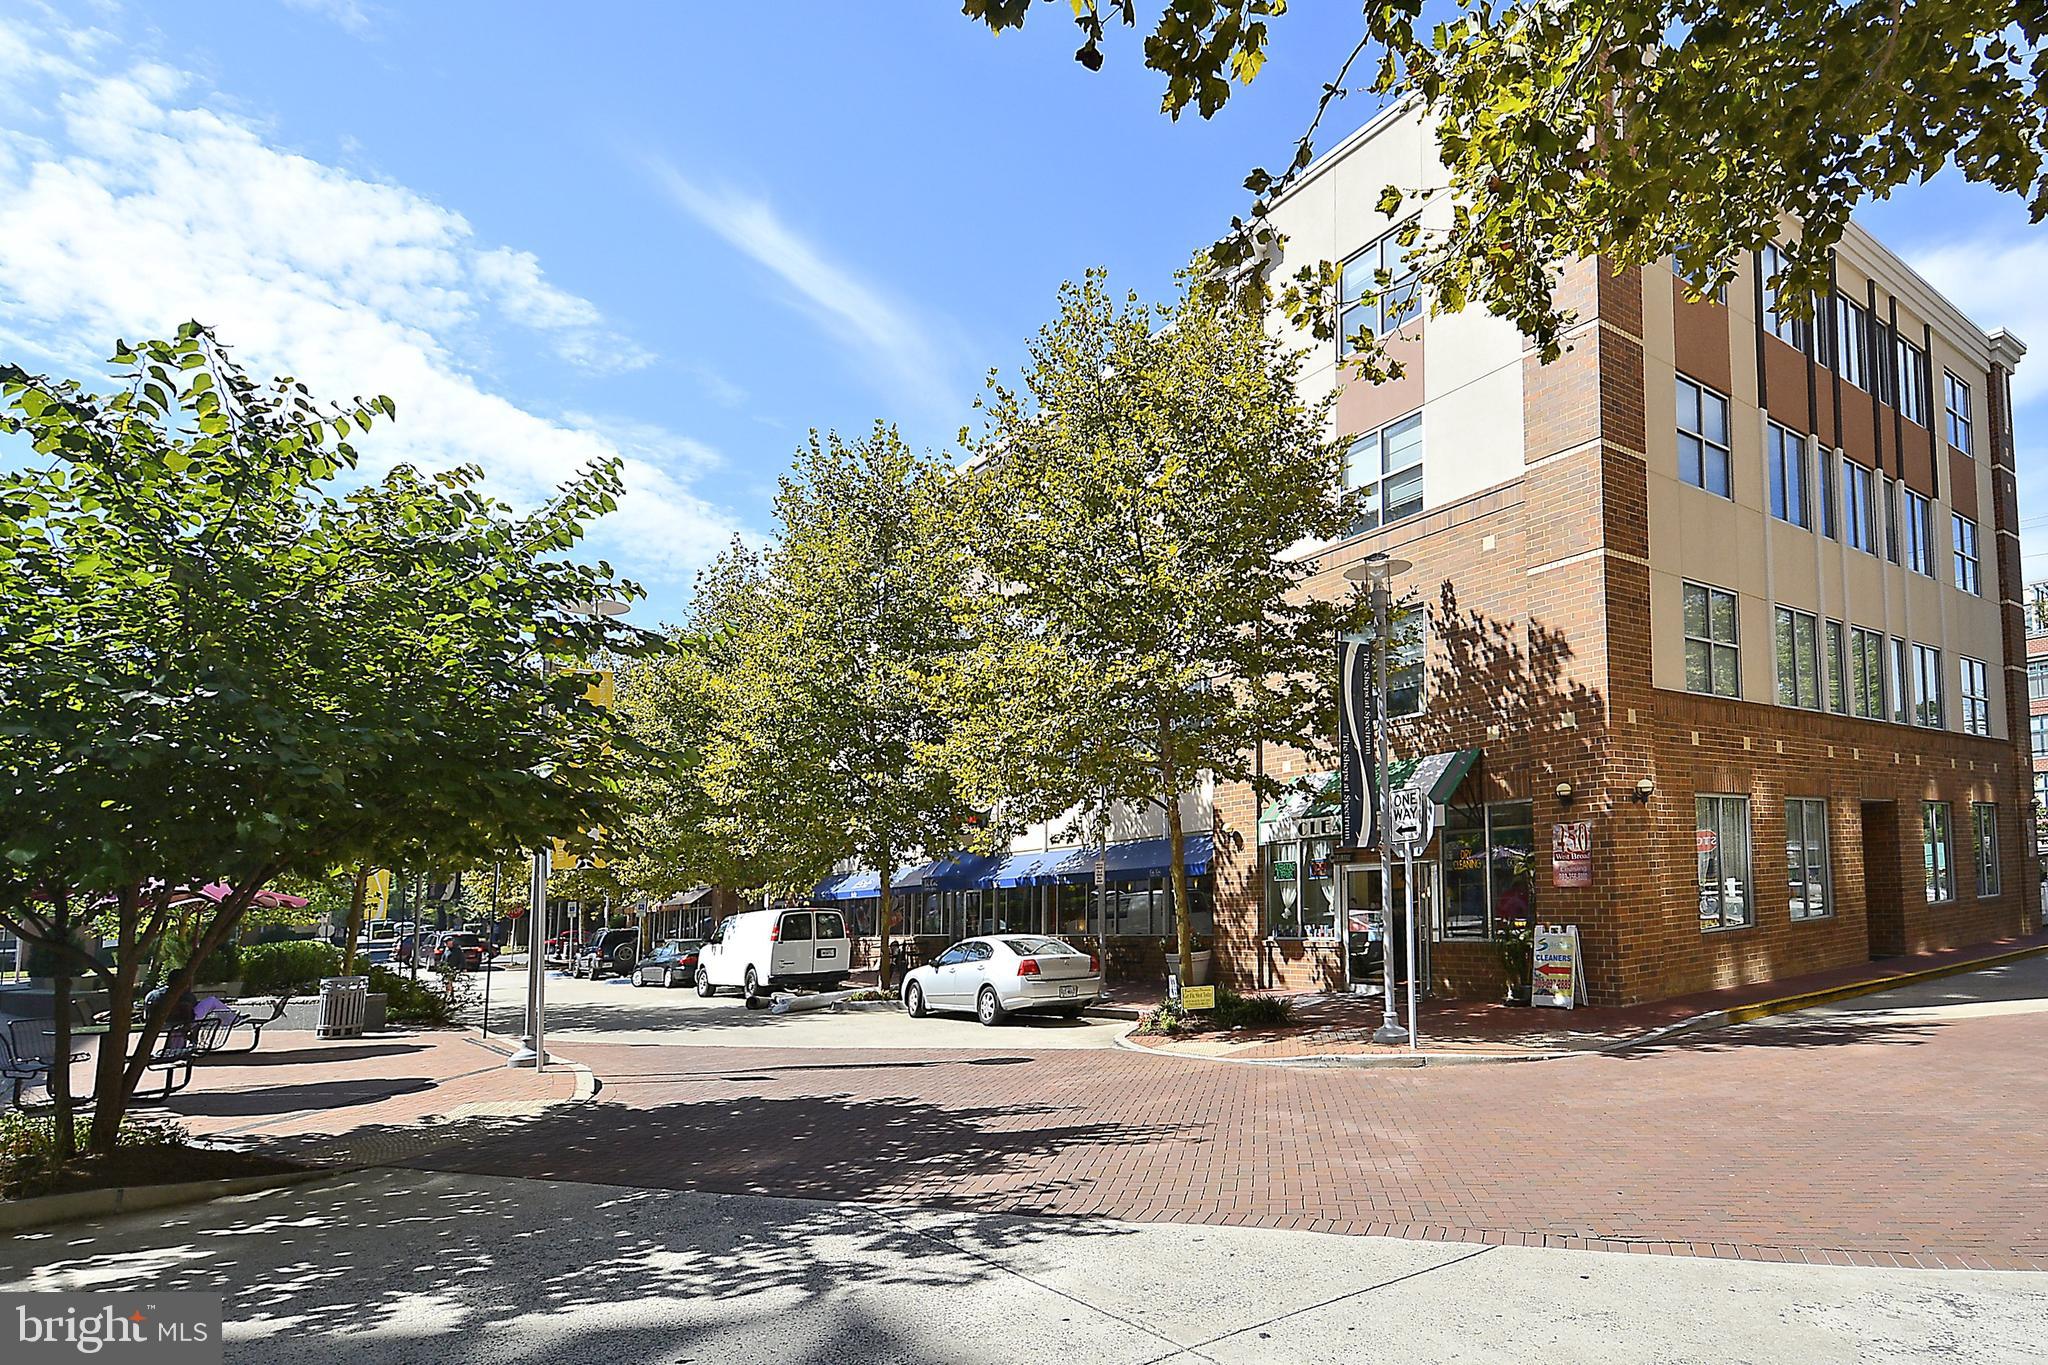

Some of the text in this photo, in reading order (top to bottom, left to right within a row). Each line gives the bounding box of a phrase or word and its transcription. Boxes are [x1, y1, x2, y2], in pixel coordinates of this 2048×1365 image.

[1363, 670, 1371, 698] Shops
[1364, 700, 1370, 709] at
[1363, 710, 1372, 755] Spectrum
[1342, 733, 1351, 840] The Shops at Spectrum
[1393, 792, 1418, 807] ONE
[1393, 806, 1418, 822] WAY
[1297, 818, 1342, 837] CLEA
[1460, 849, 1472, 860] DRY
[1571, 852, 1590, 860] Broad
[1453, 859, 1482, 870] CLEANING
[1535, 954, 1572, 962] CLEANERS
